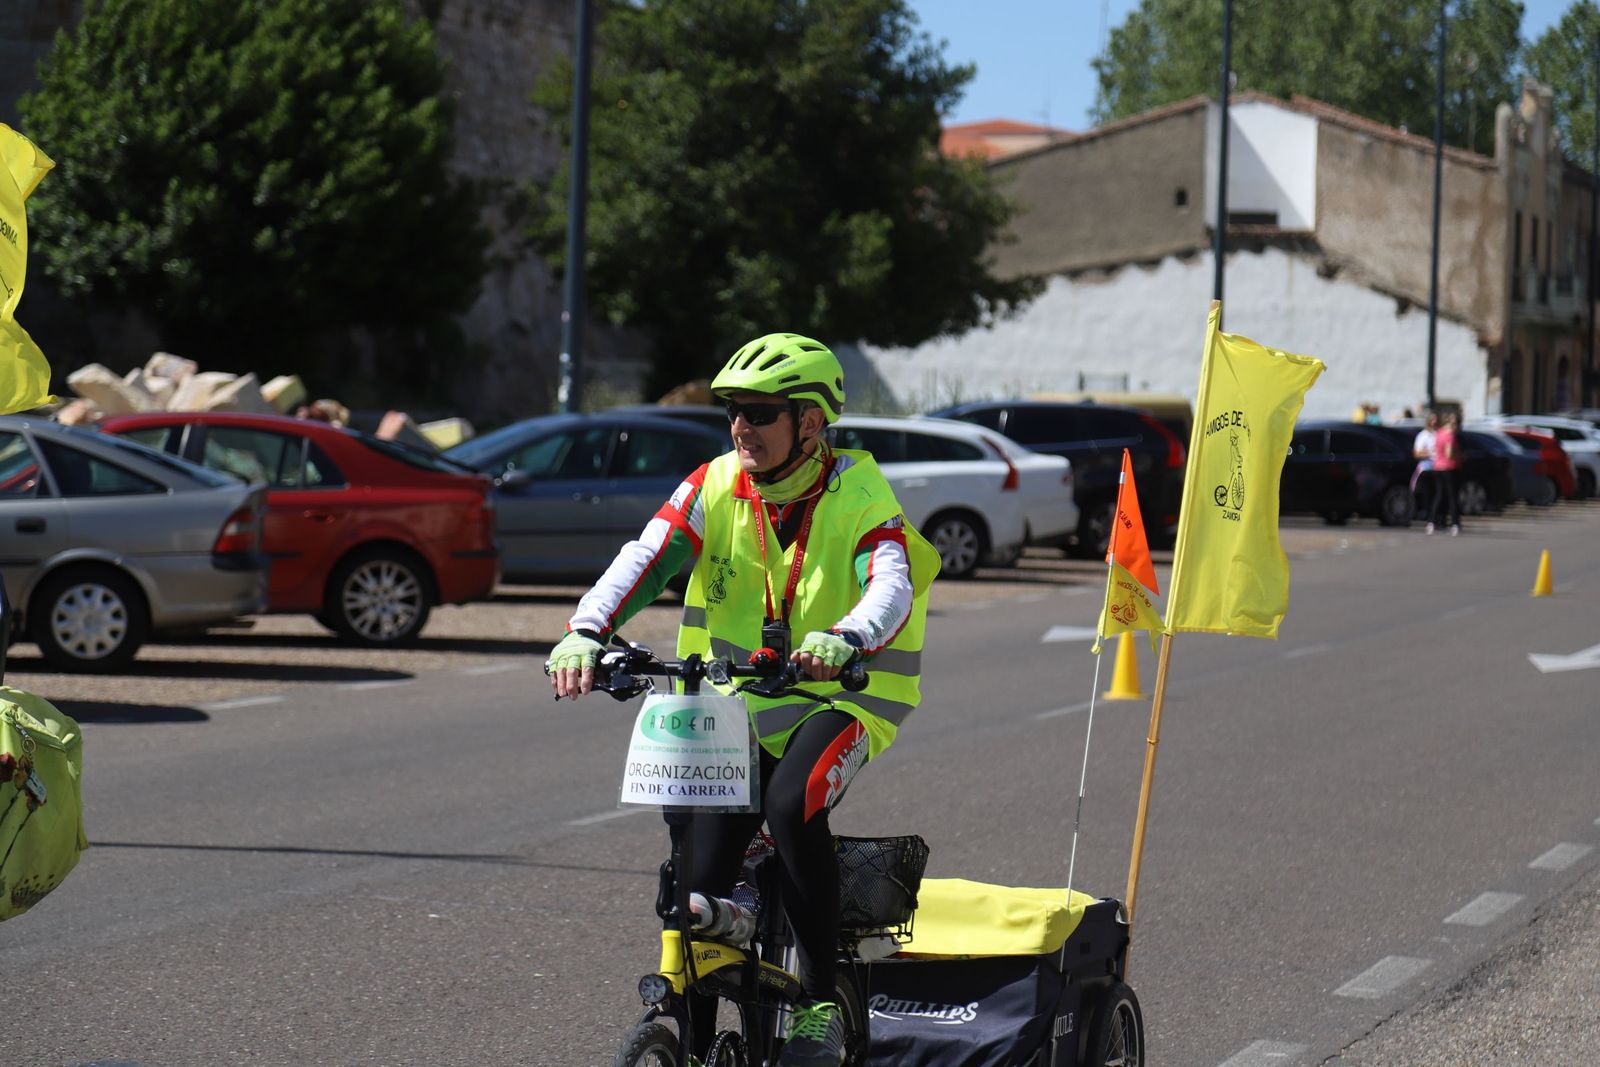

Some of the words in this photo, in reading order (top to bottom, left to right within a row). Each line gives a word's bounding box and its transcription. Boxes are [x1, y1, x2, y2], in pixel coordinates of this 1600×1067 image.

[1205, 412, 1230, 440] AMIGOS
[1231, 410, 1243, 427] DE
[791, 546, 805, 590] ETHICON
[650, 715, 715, 731] AZDEM
[628, 761, 746, 780] ORGANIZACIÓN
[630, 782, 646, 793] FIN
[648, 783, 665, 795] DE
[667, 784, 736, 796] CARRERA
[869, 993, 979, 1022] PHILLIPS
